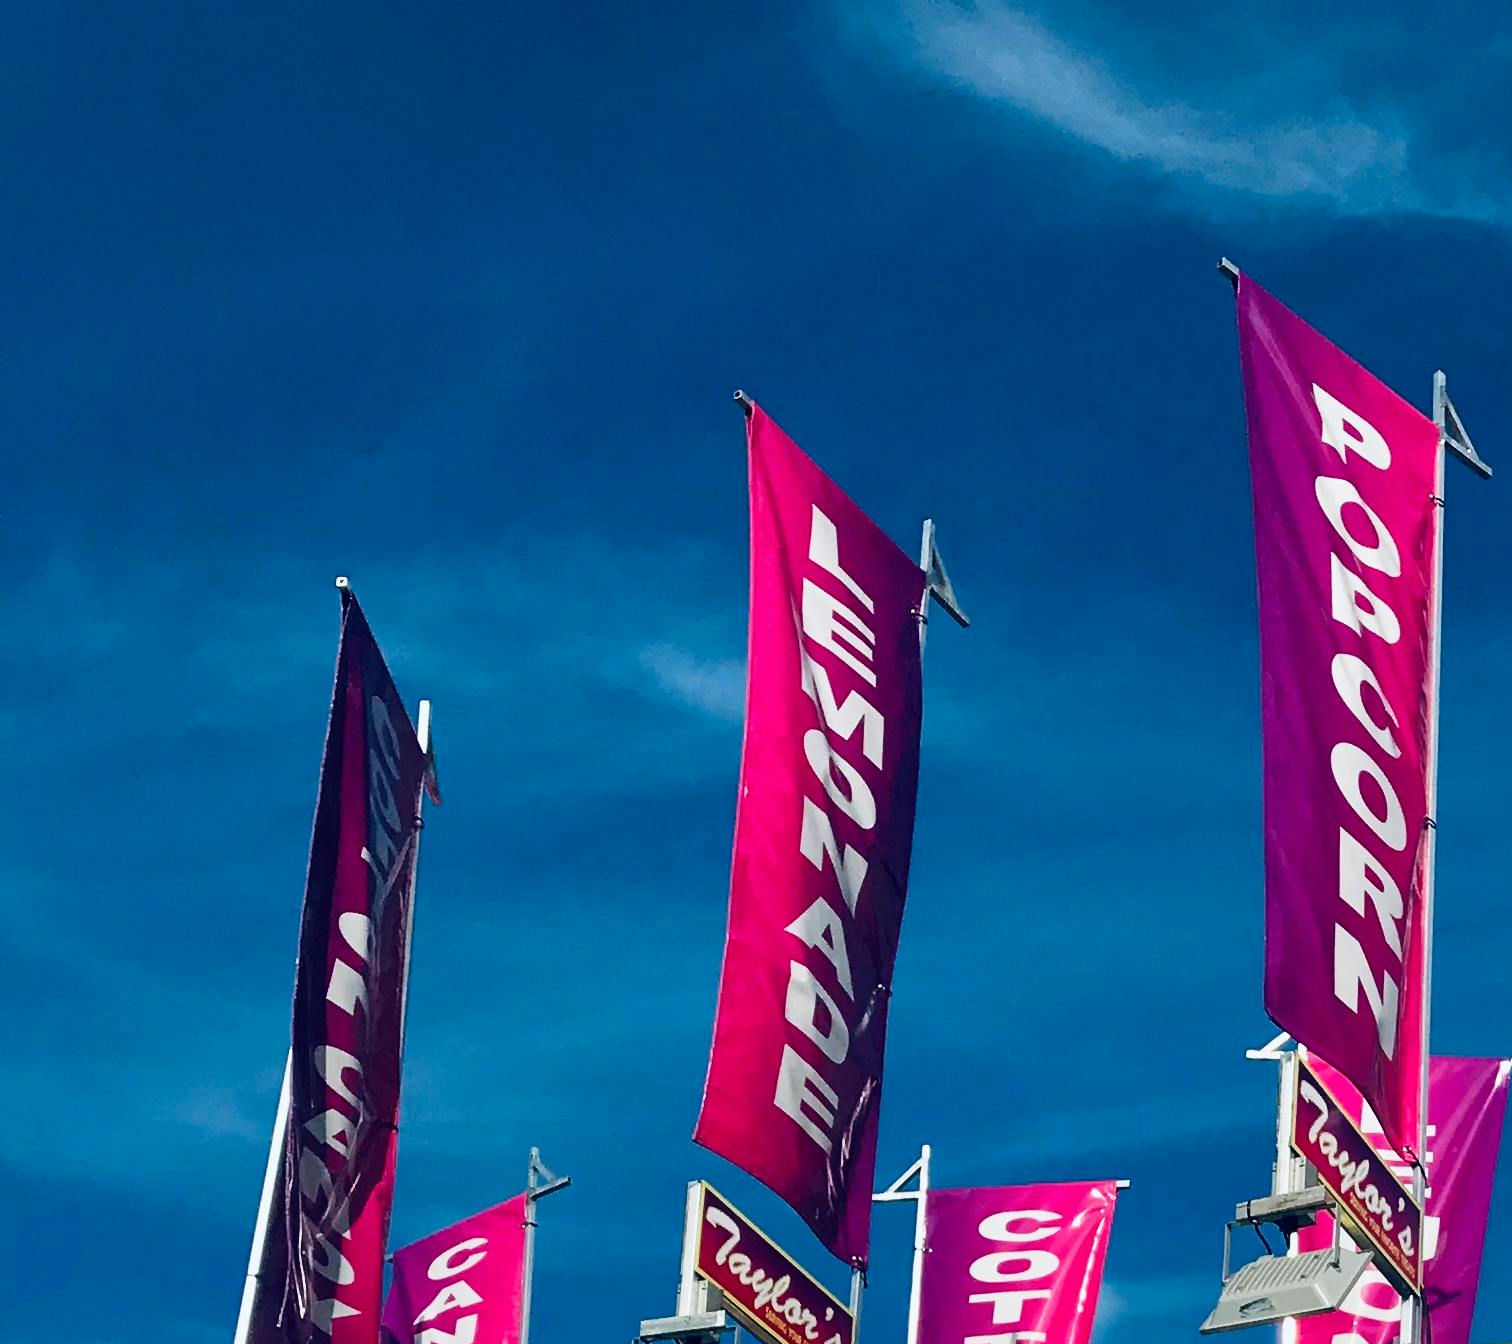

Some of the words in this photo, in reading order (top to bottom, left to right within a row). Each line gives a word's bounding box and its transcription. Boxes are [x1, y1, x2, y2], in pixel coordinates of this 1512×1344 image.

[774, 503, 885, 1155] LEMONADE
[1312, 381, 1407, 1061] POPCORN
[1301, 1080, 1415, 1257] Taylor's
